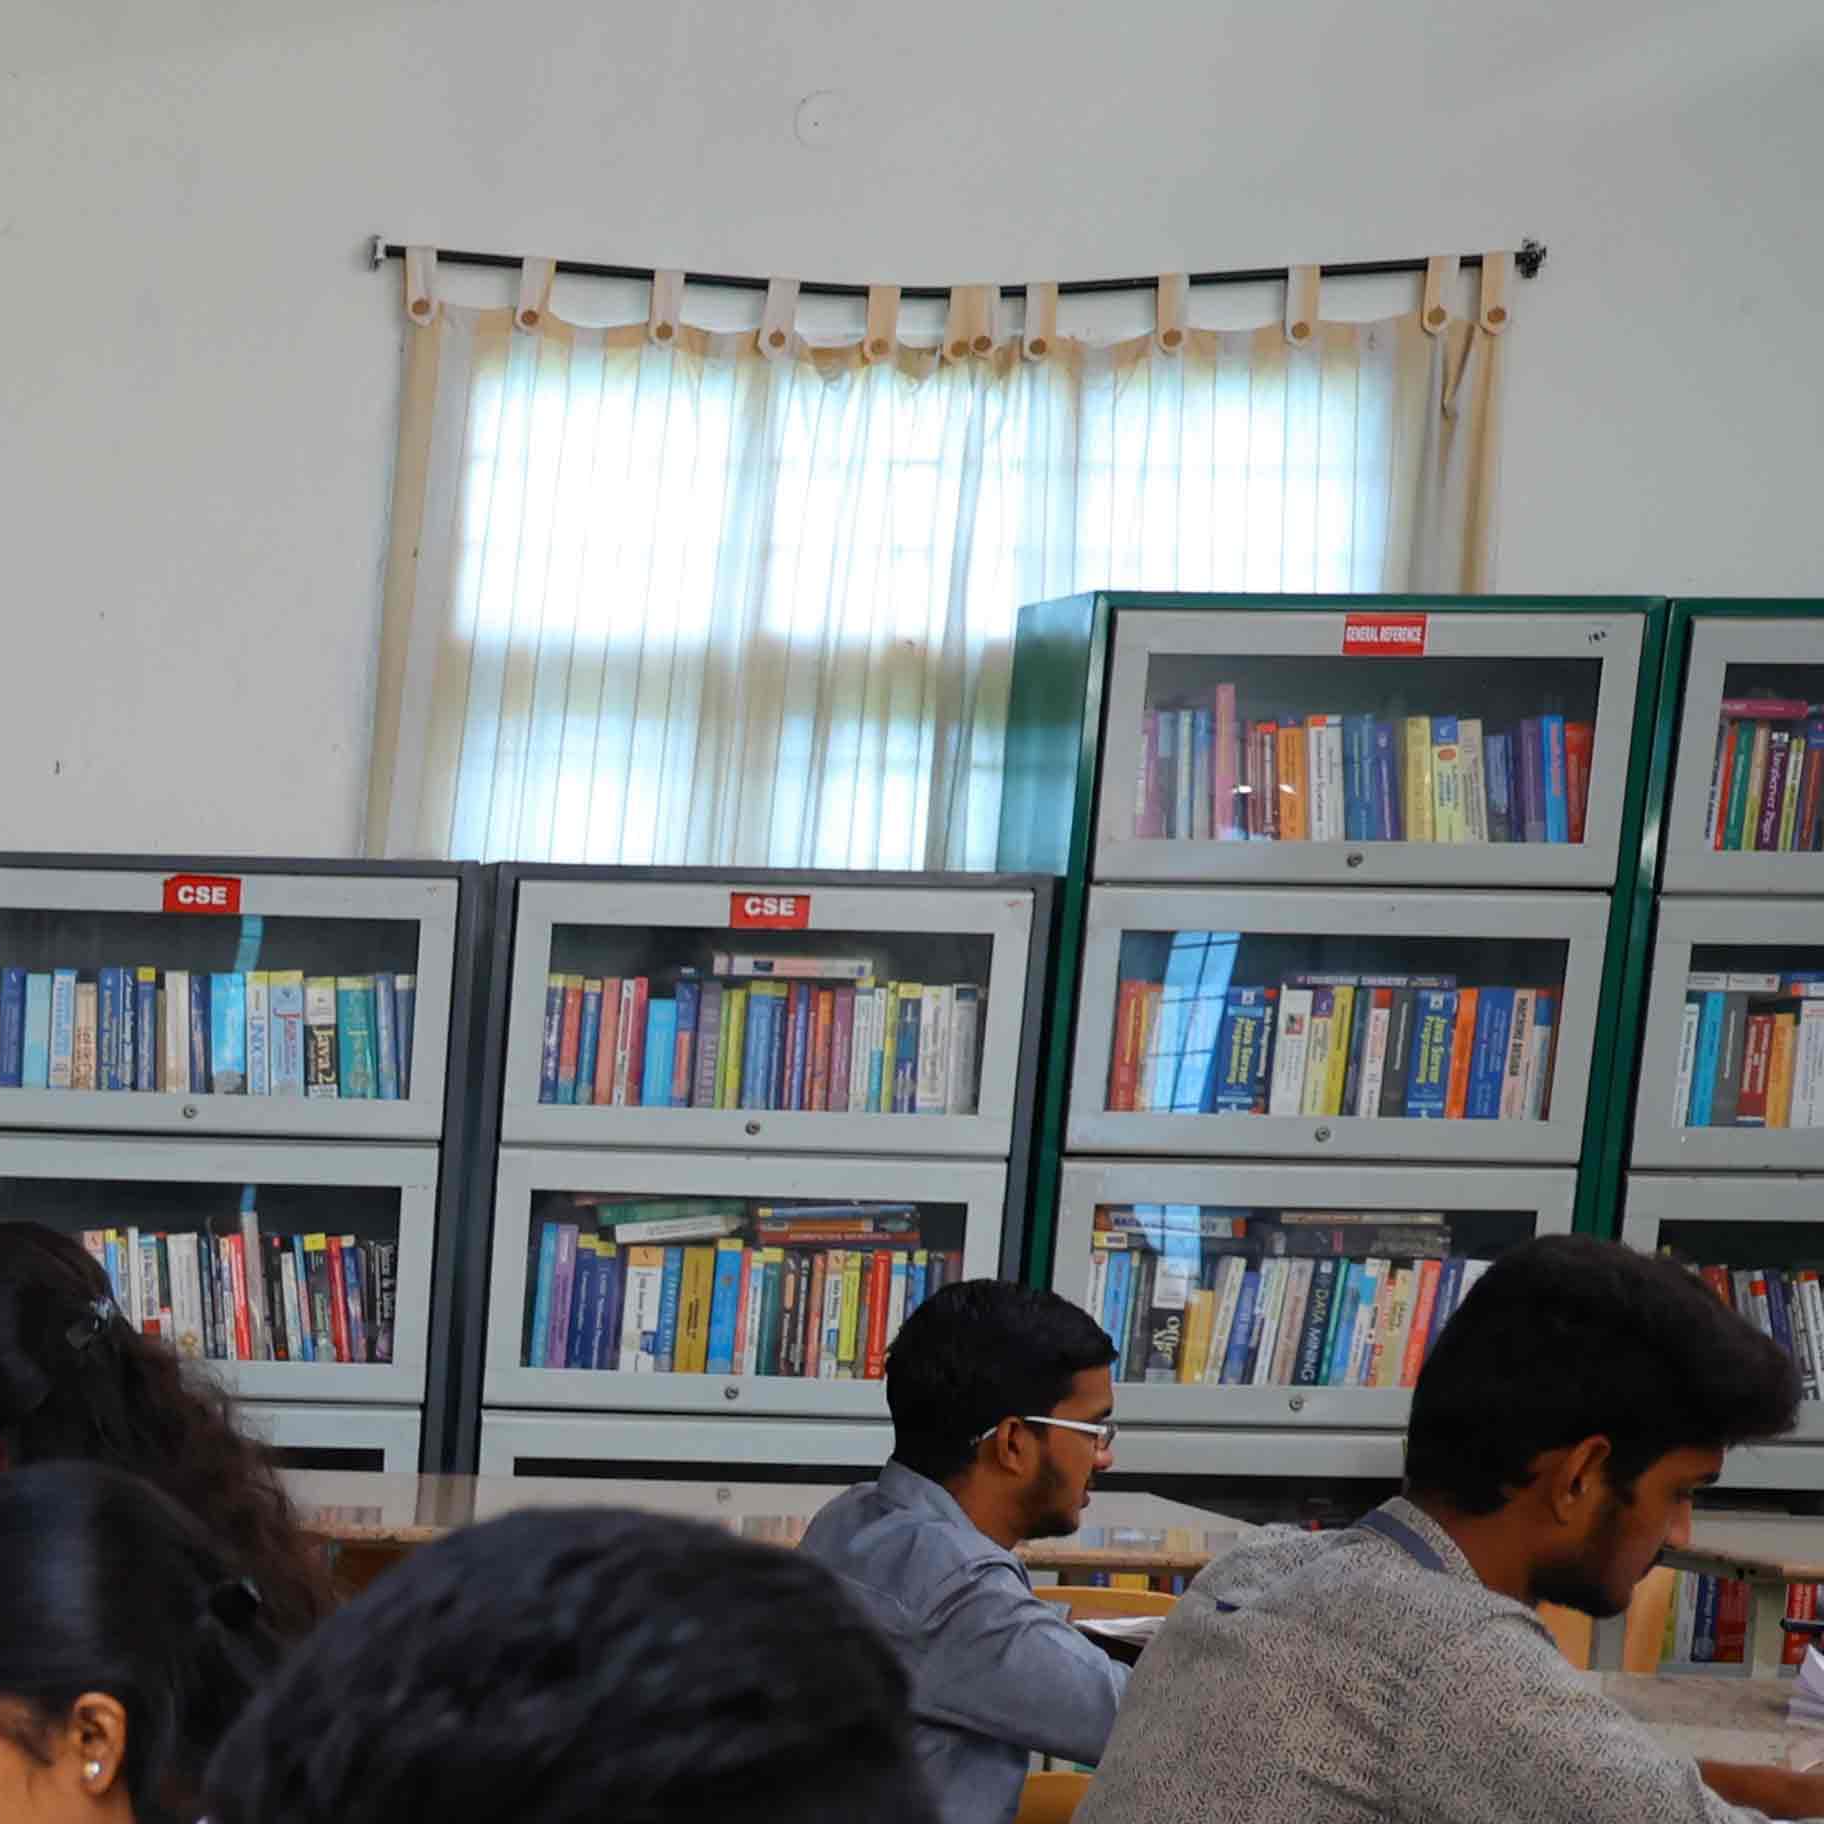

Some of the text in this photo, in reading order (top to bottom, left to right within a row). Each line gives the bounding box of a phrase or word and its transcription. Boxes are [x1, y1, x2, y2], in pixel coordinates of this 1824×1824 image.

[177, 885, 228, 904] CSE
[744, 896, 795, 916] CSE
[312, 1026, 336, 1070] Java
[1430, 1018, 1449, 1085] Java Server
[1300, 1288, 1329, 1382] DATA MINING
